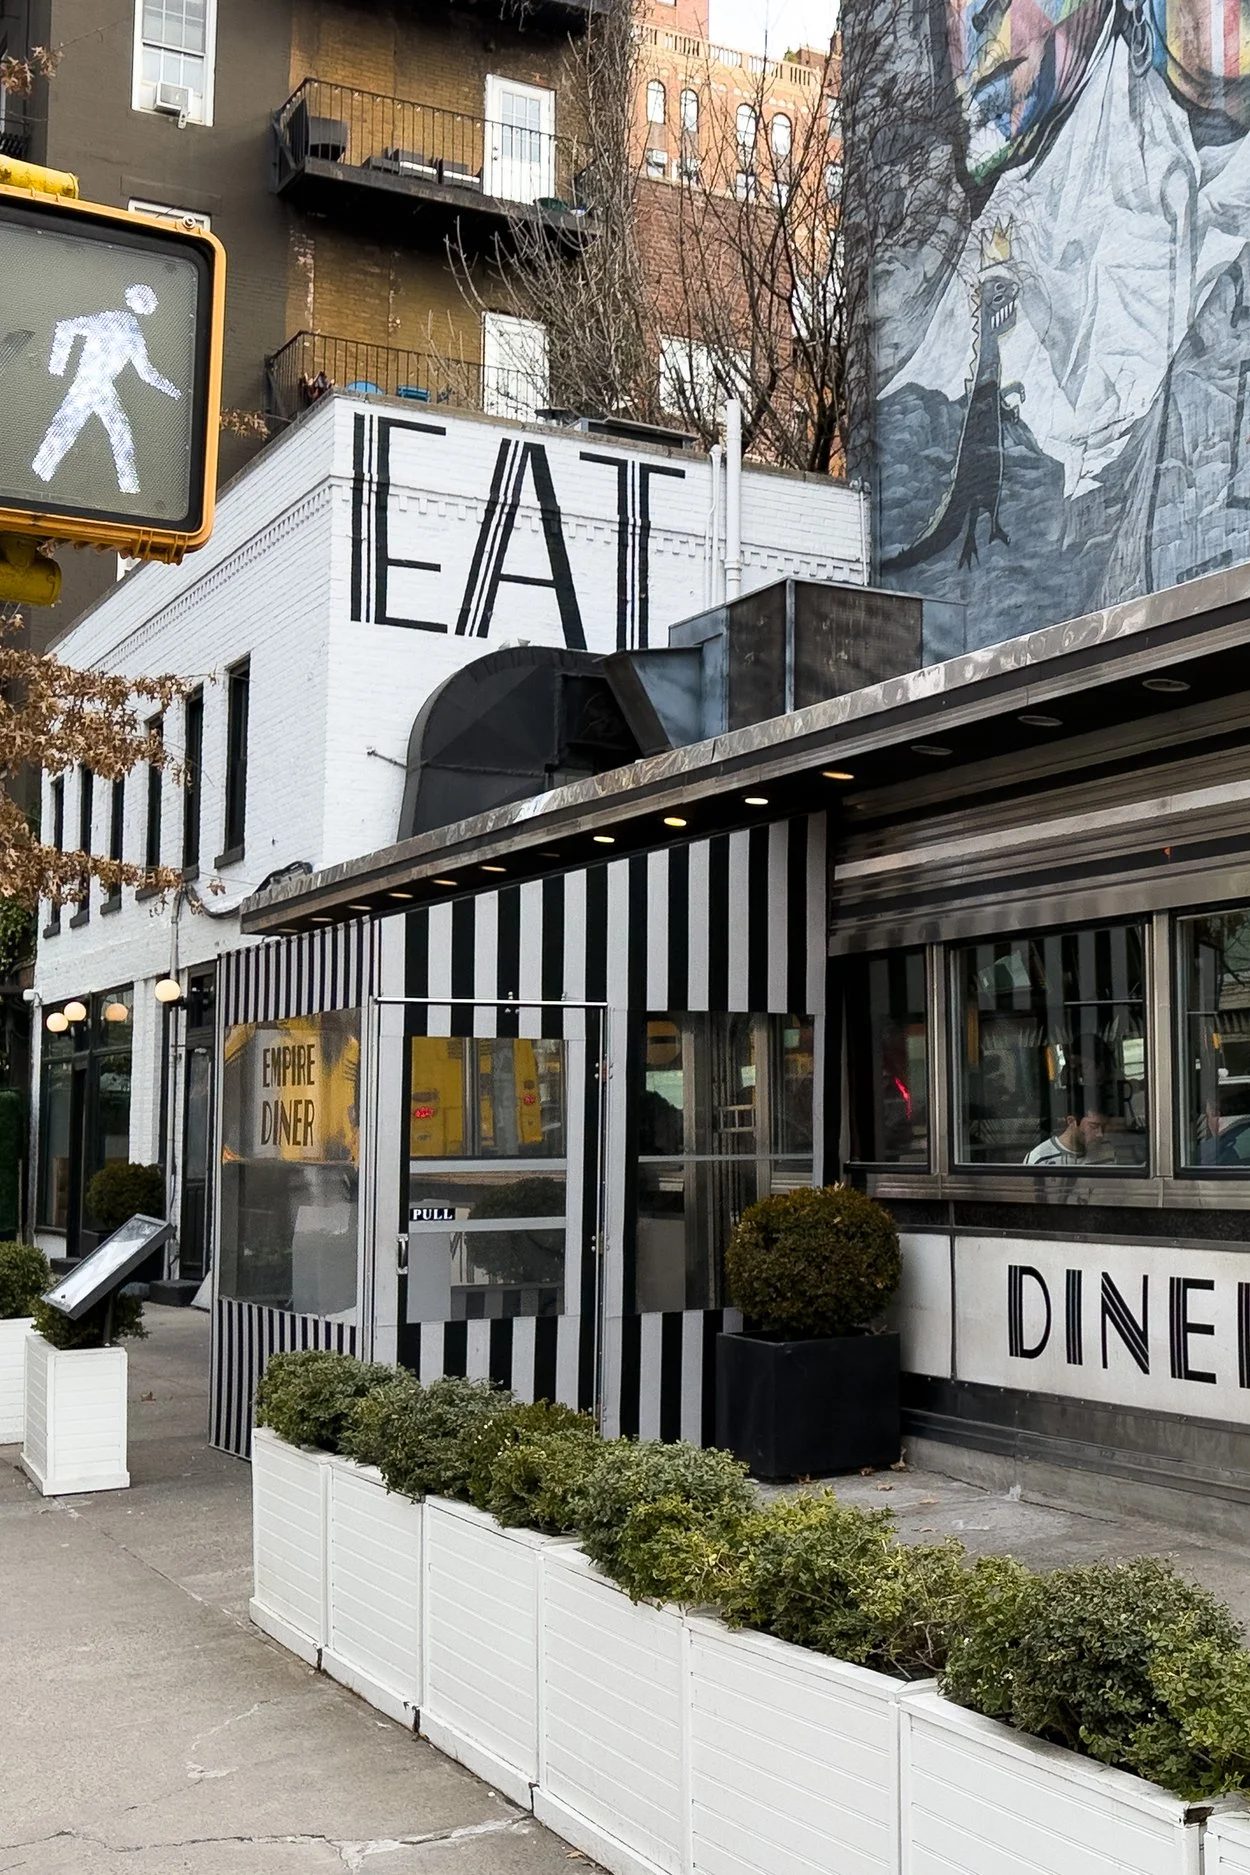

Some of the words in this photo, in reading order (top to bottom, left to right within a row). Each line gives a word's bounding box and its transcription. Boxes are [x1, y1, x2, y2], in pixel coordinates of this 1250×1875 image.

[351, 411, 686, 650] EAT
[262, 1044, 316, 1088] EMPIRE
[261, 1099, 315, 1146] DINER
[412, 1208, 453, 1220] PULL
